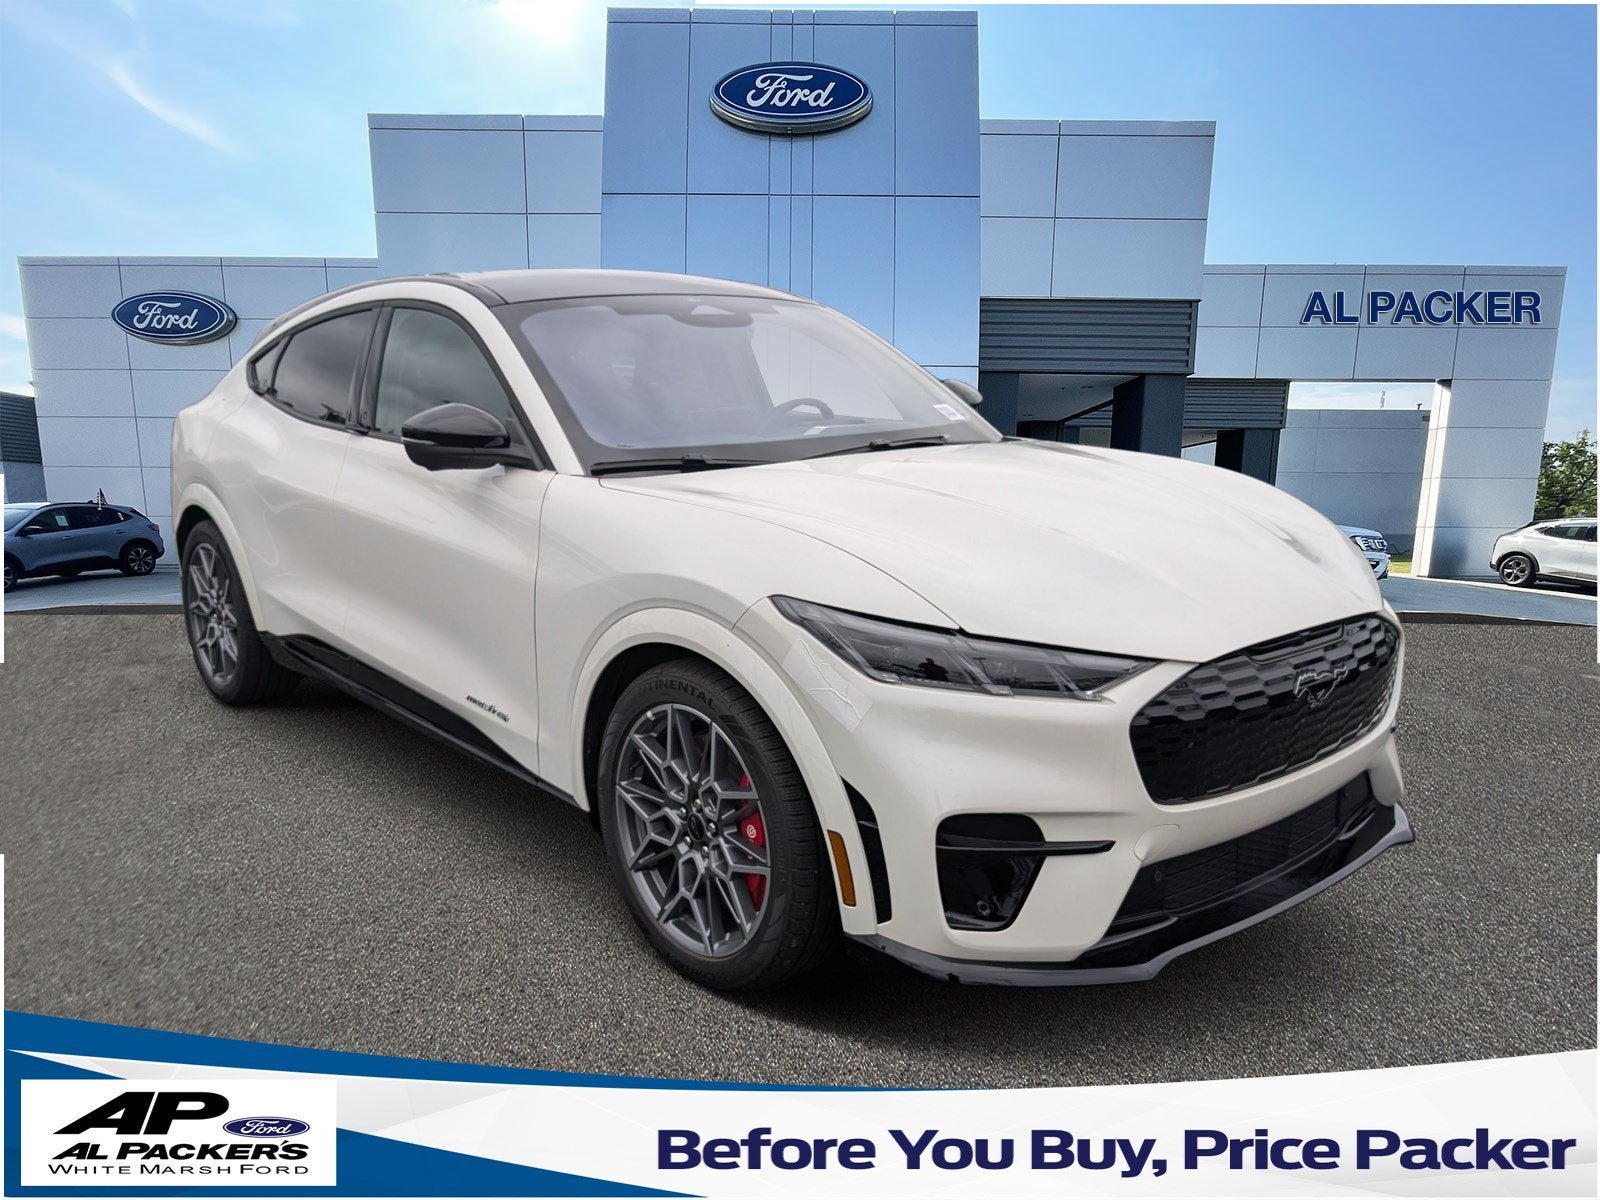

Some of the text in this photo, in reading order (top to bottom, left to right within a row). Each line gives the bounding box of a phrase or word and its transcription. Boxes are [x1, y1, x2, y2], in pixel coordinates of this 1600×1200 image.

[746, 73, 836, 107] Ford
[133, 301, 198, 329] Ford
[1302, 290, 1542, 324] AL PACKER
[633, 679, 716, 711] TINENTAL
